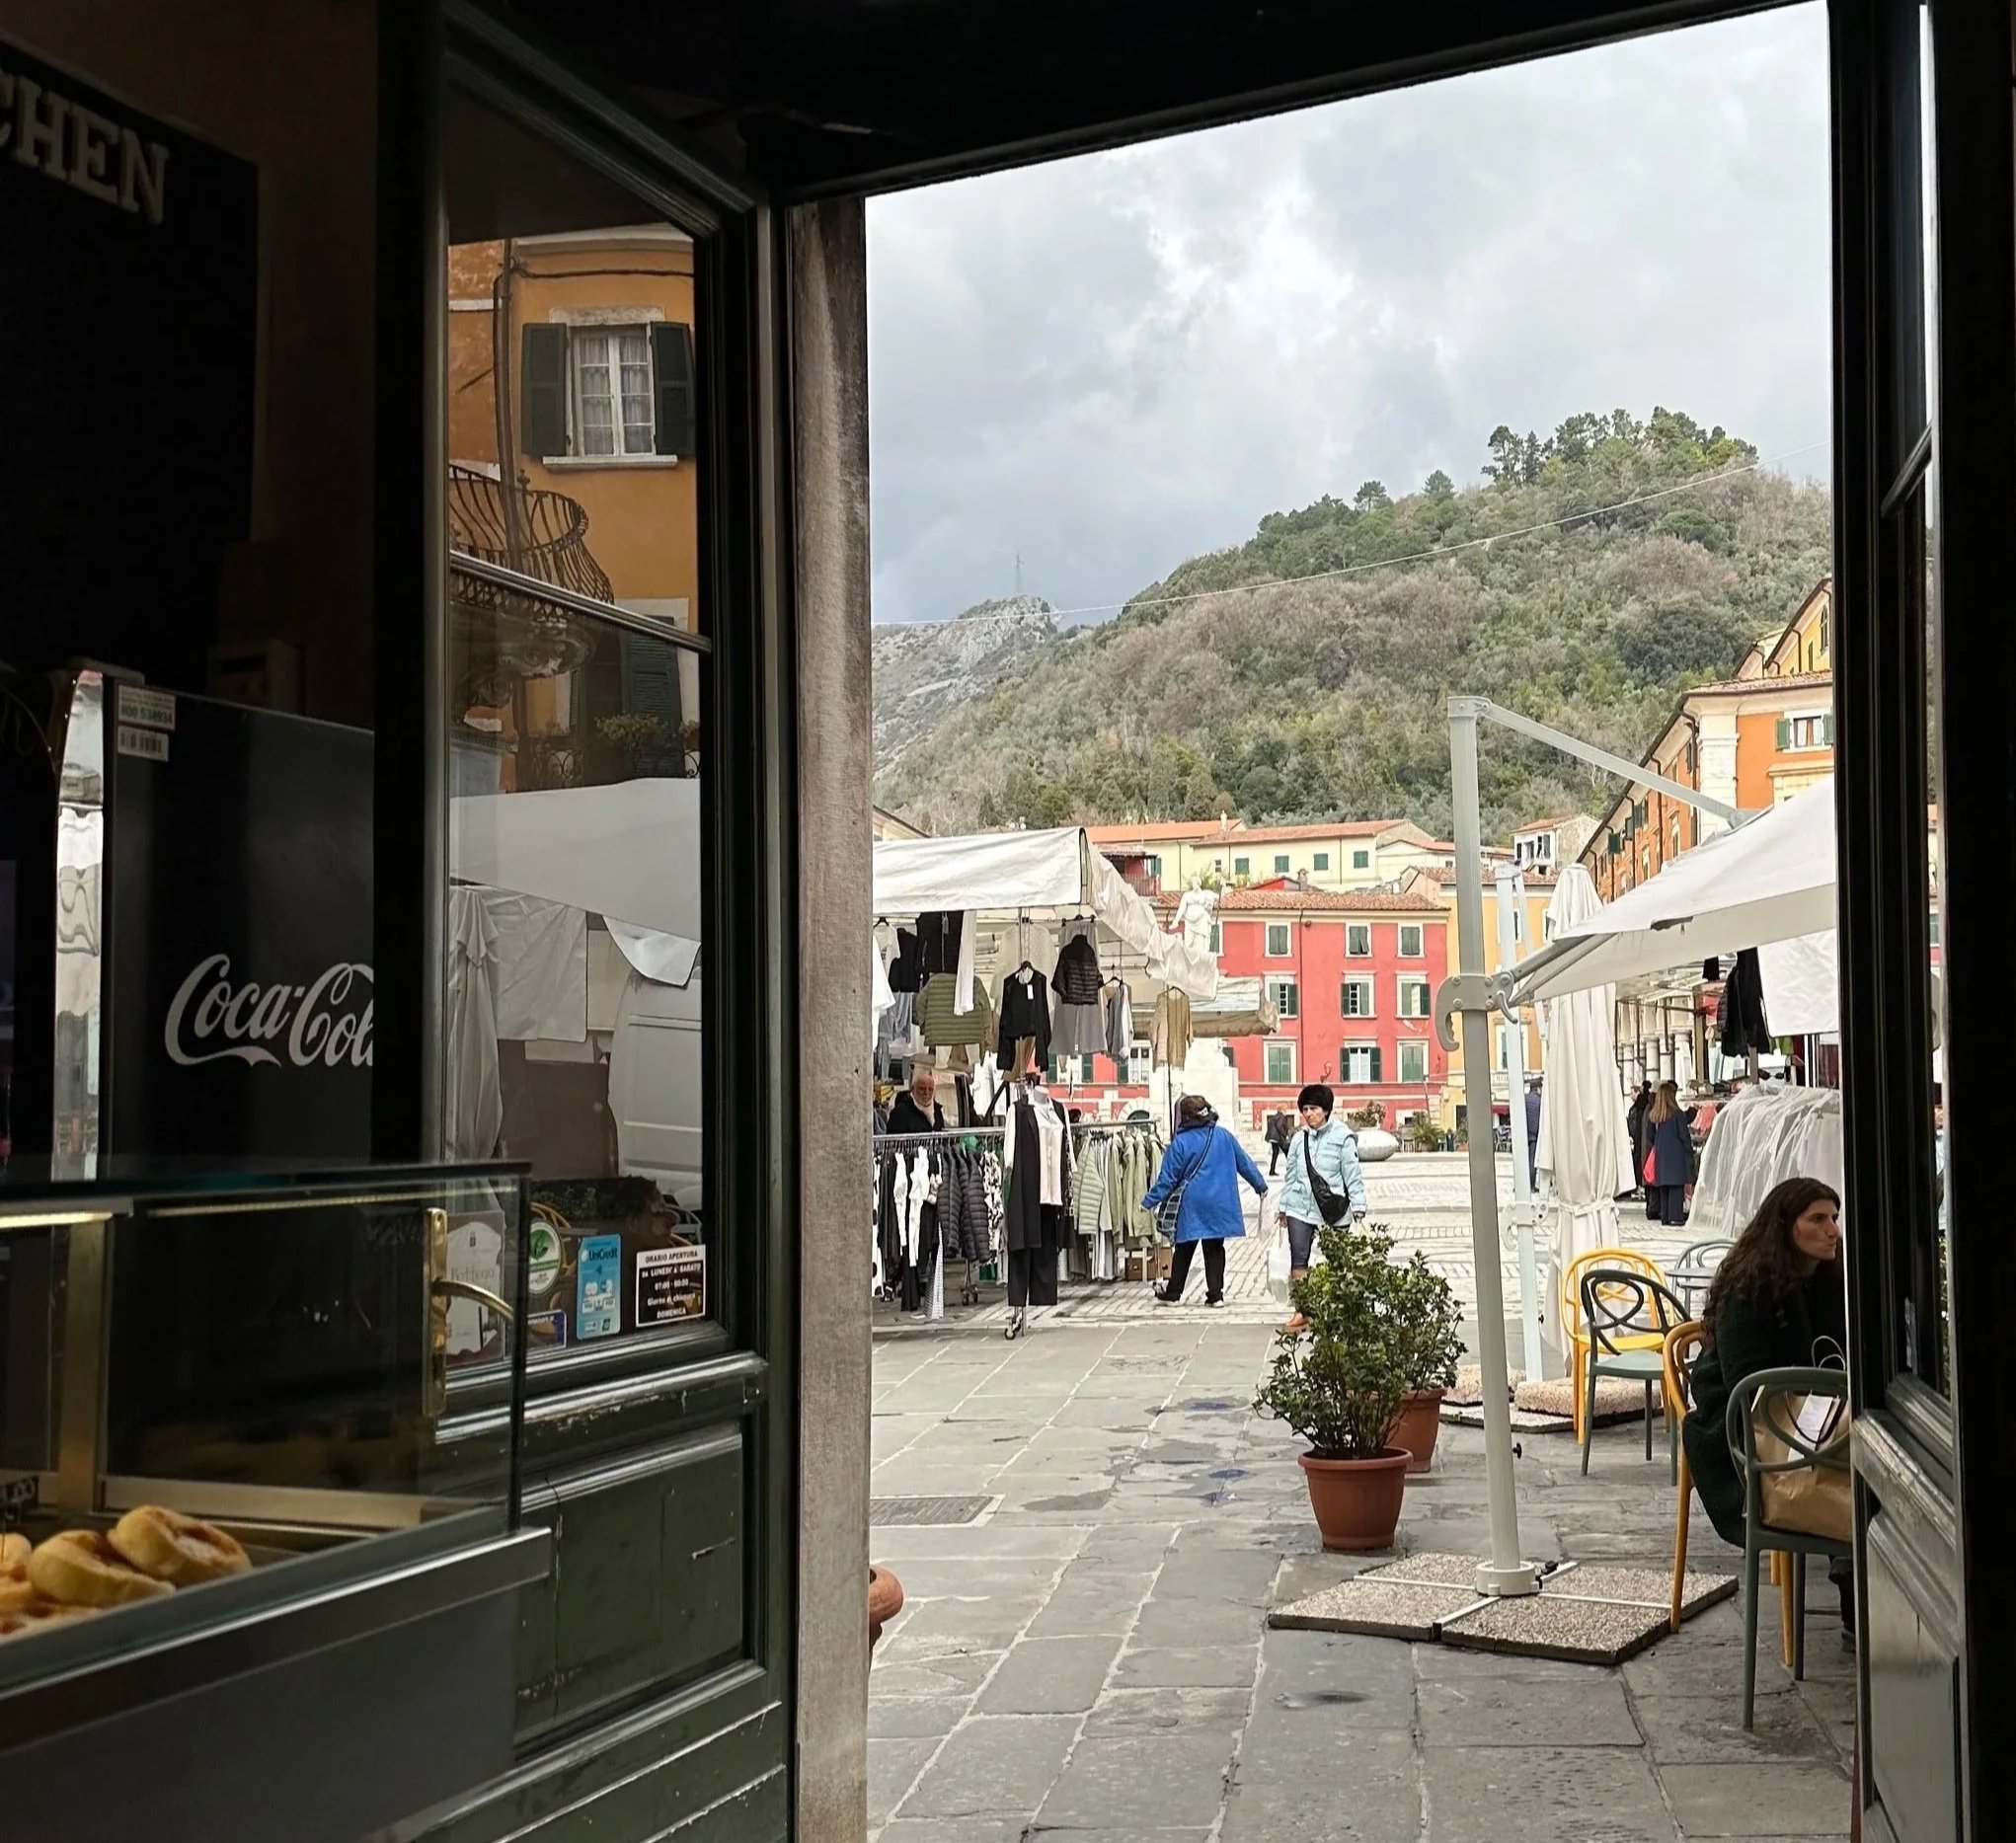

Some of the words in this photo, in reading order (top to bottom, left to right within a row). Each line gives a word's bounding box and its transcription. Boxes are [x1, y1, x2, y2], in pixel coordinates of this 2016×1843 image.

[164, 953, 374, 1068] Coca-Col
[646, 1254, 667, 1264] ORARIO
[668, 1251, 697, 1261] APERTURA
[679, 1263, 702, 1273] SABATO
[657, 1307, 686, 1319] DOMENICA
